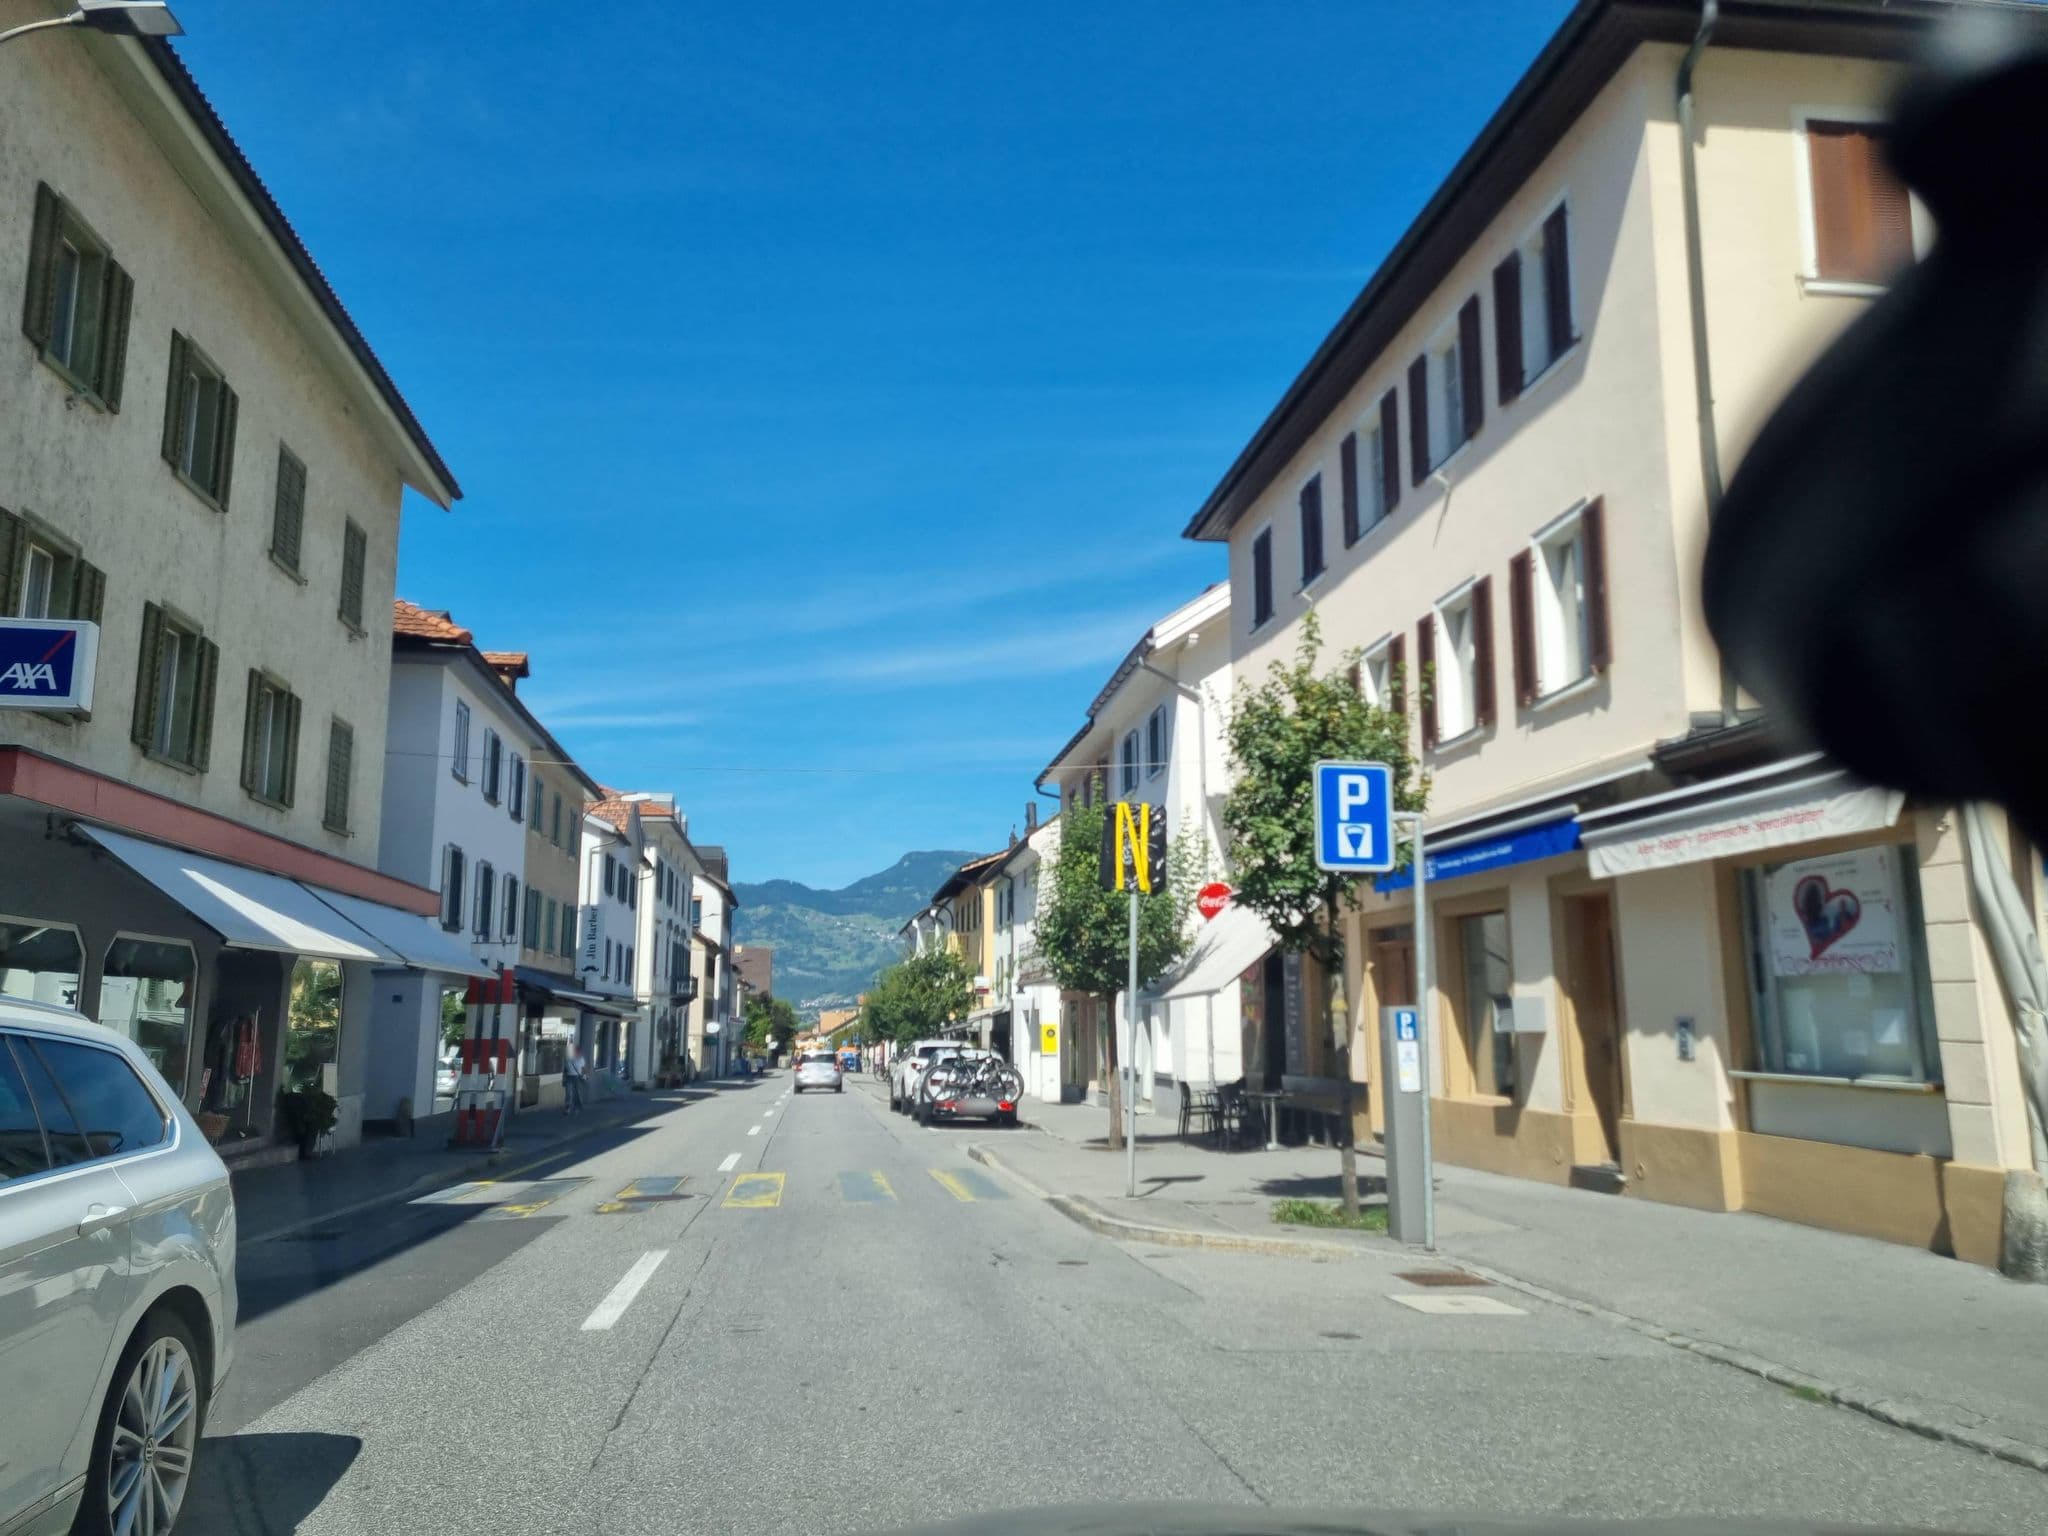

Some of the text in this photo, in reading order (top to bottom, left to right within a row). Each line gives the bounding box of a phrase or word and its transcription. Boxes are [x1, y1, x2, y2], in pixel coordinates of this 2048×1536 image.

[0, 663, 57, 690] AXA
[1338, 774, 1369, 821] P
[587, 905, 598, 940] Barber
